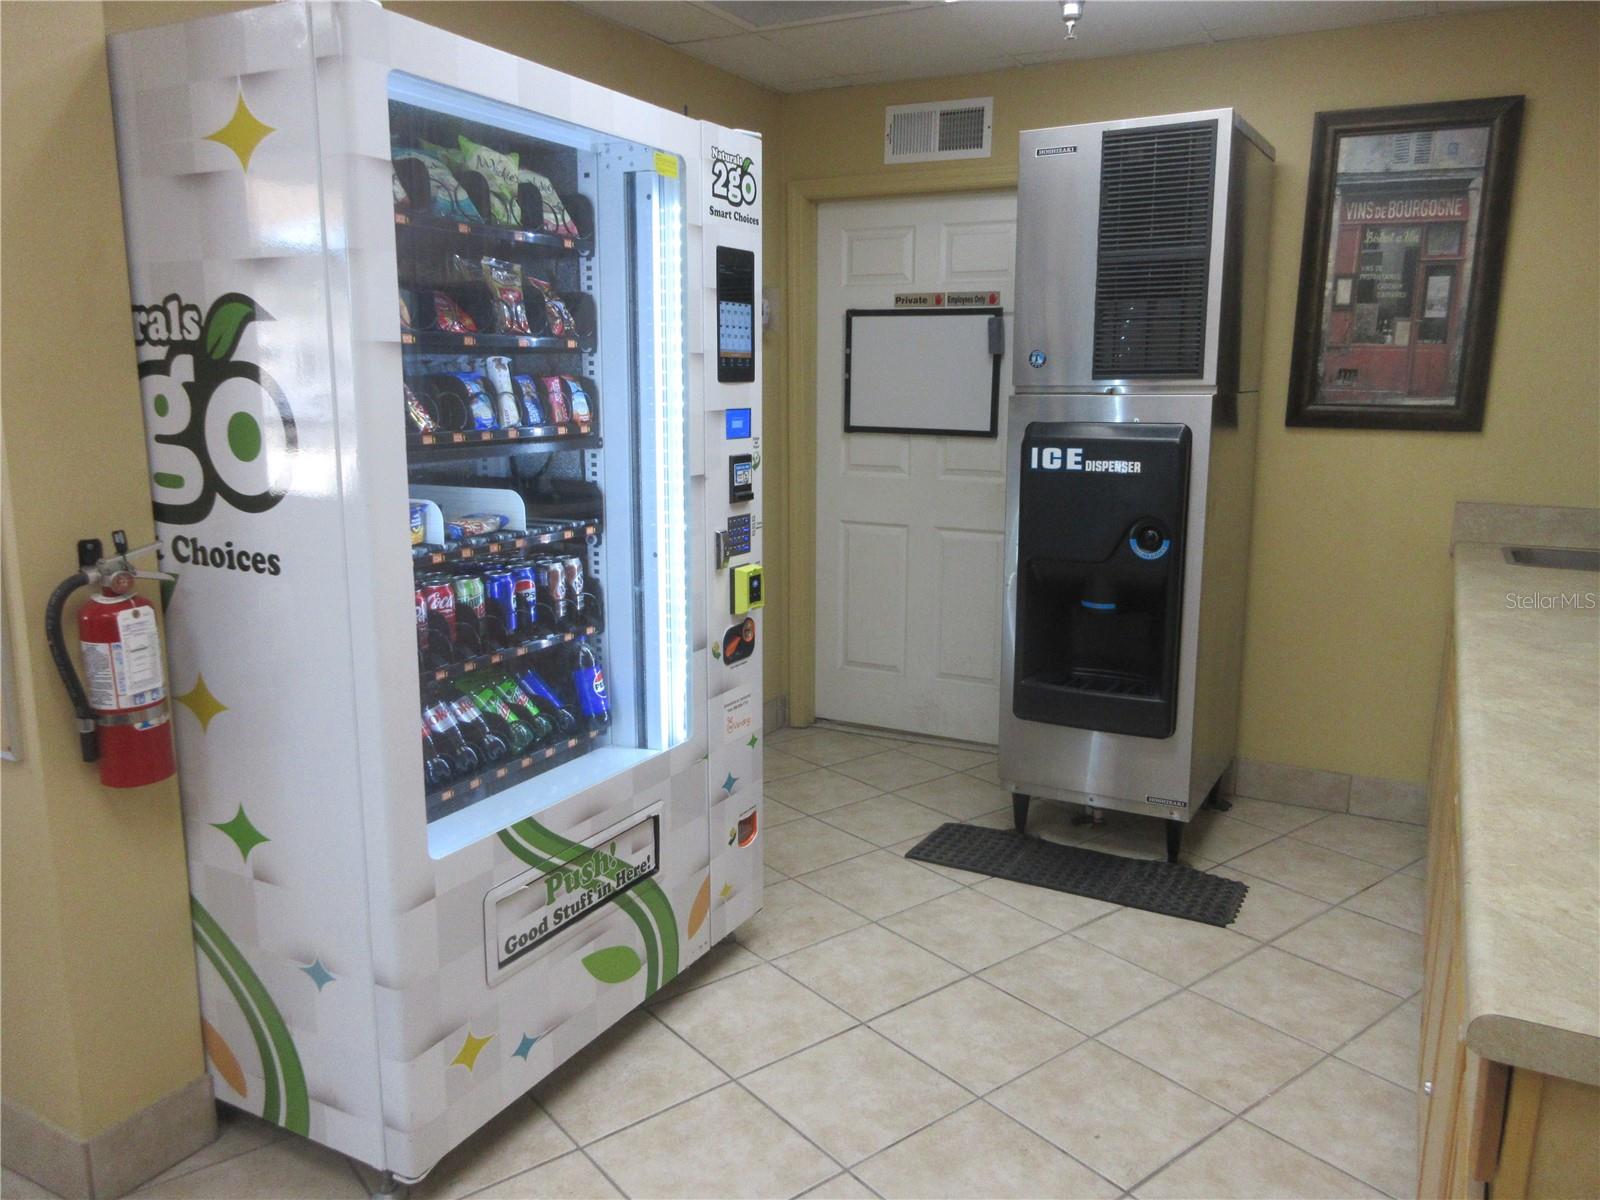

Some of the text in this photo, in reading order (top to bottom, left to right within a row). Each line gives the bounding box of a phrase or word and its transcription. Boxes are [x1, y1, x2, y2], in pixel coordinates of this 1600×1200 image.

[709, 206, 760, 226] Smart Choices
[1346, 201, 1376, 220] VINS
[1388, 197, 1463, 218] BOURGOGNE
[895, 295, 928, 305] Private
[947, 295, 986, 305] Employees Only
[1031, 447, 1141, 473] ICE DISPENSER
[171, 535, 281, 576] Choices
[544, 841, 618, 906] Push!
[504, 855, 651, 954] Good Stuff in Here!
